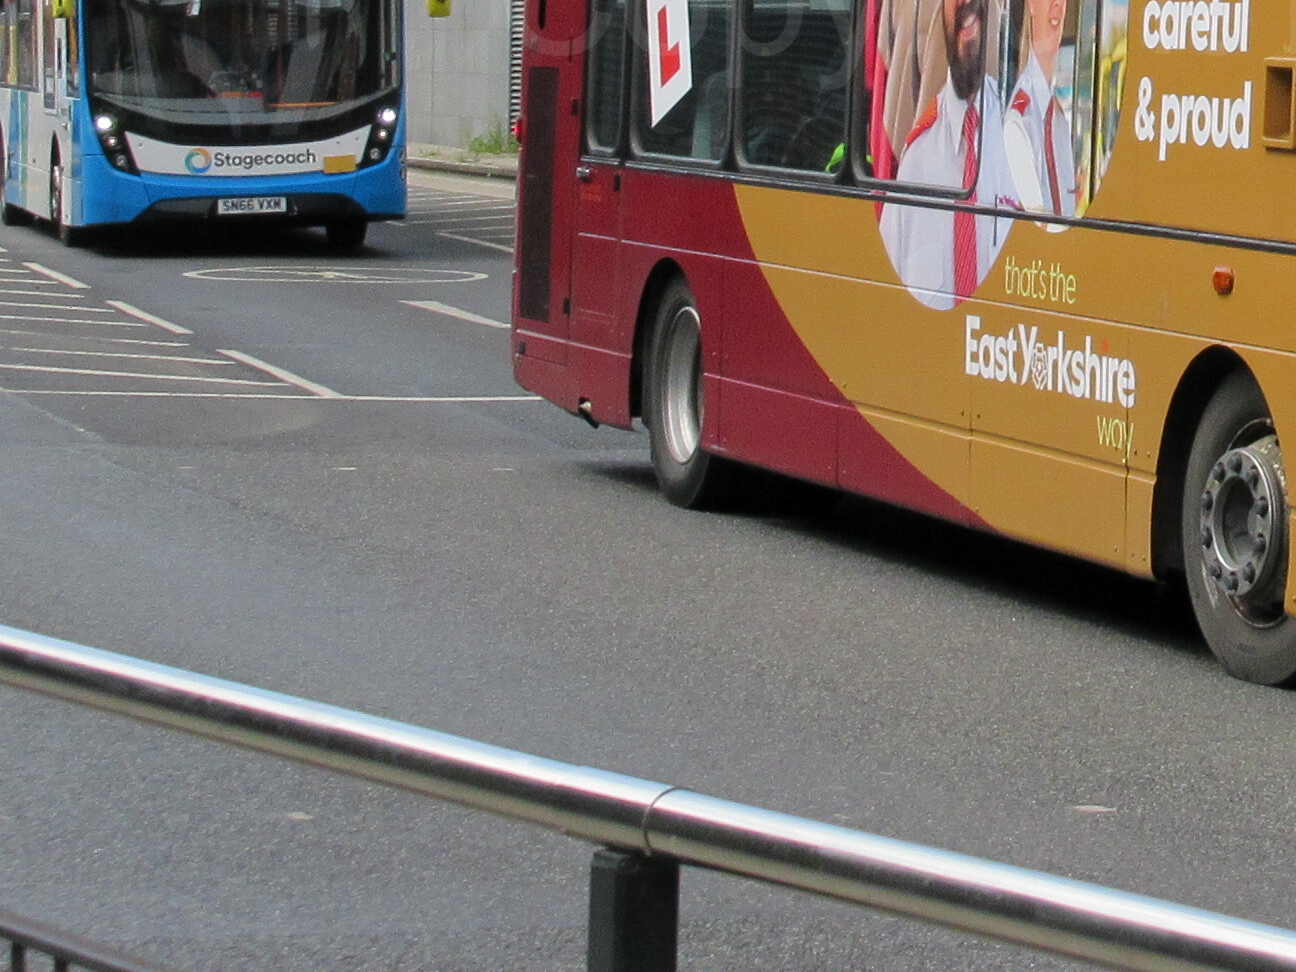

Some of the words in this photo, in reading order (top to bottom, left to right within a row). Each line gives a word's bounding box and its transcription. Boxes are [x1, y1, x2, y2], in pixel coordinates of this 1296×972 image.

[657, 4, 682, 88] L
[1133, 76, 1156, 143] &
[1158, 80, 1252, 161] proud
[214, 149, 317, 170] Stagecoach
[222, 199, 256, 212] SN66
[1004, 255, 1048, 302] that's
[1049, 262, 1077, 305] the
[965, 314, 1018, 385] East
[1096, 414, 1135, 464] way
